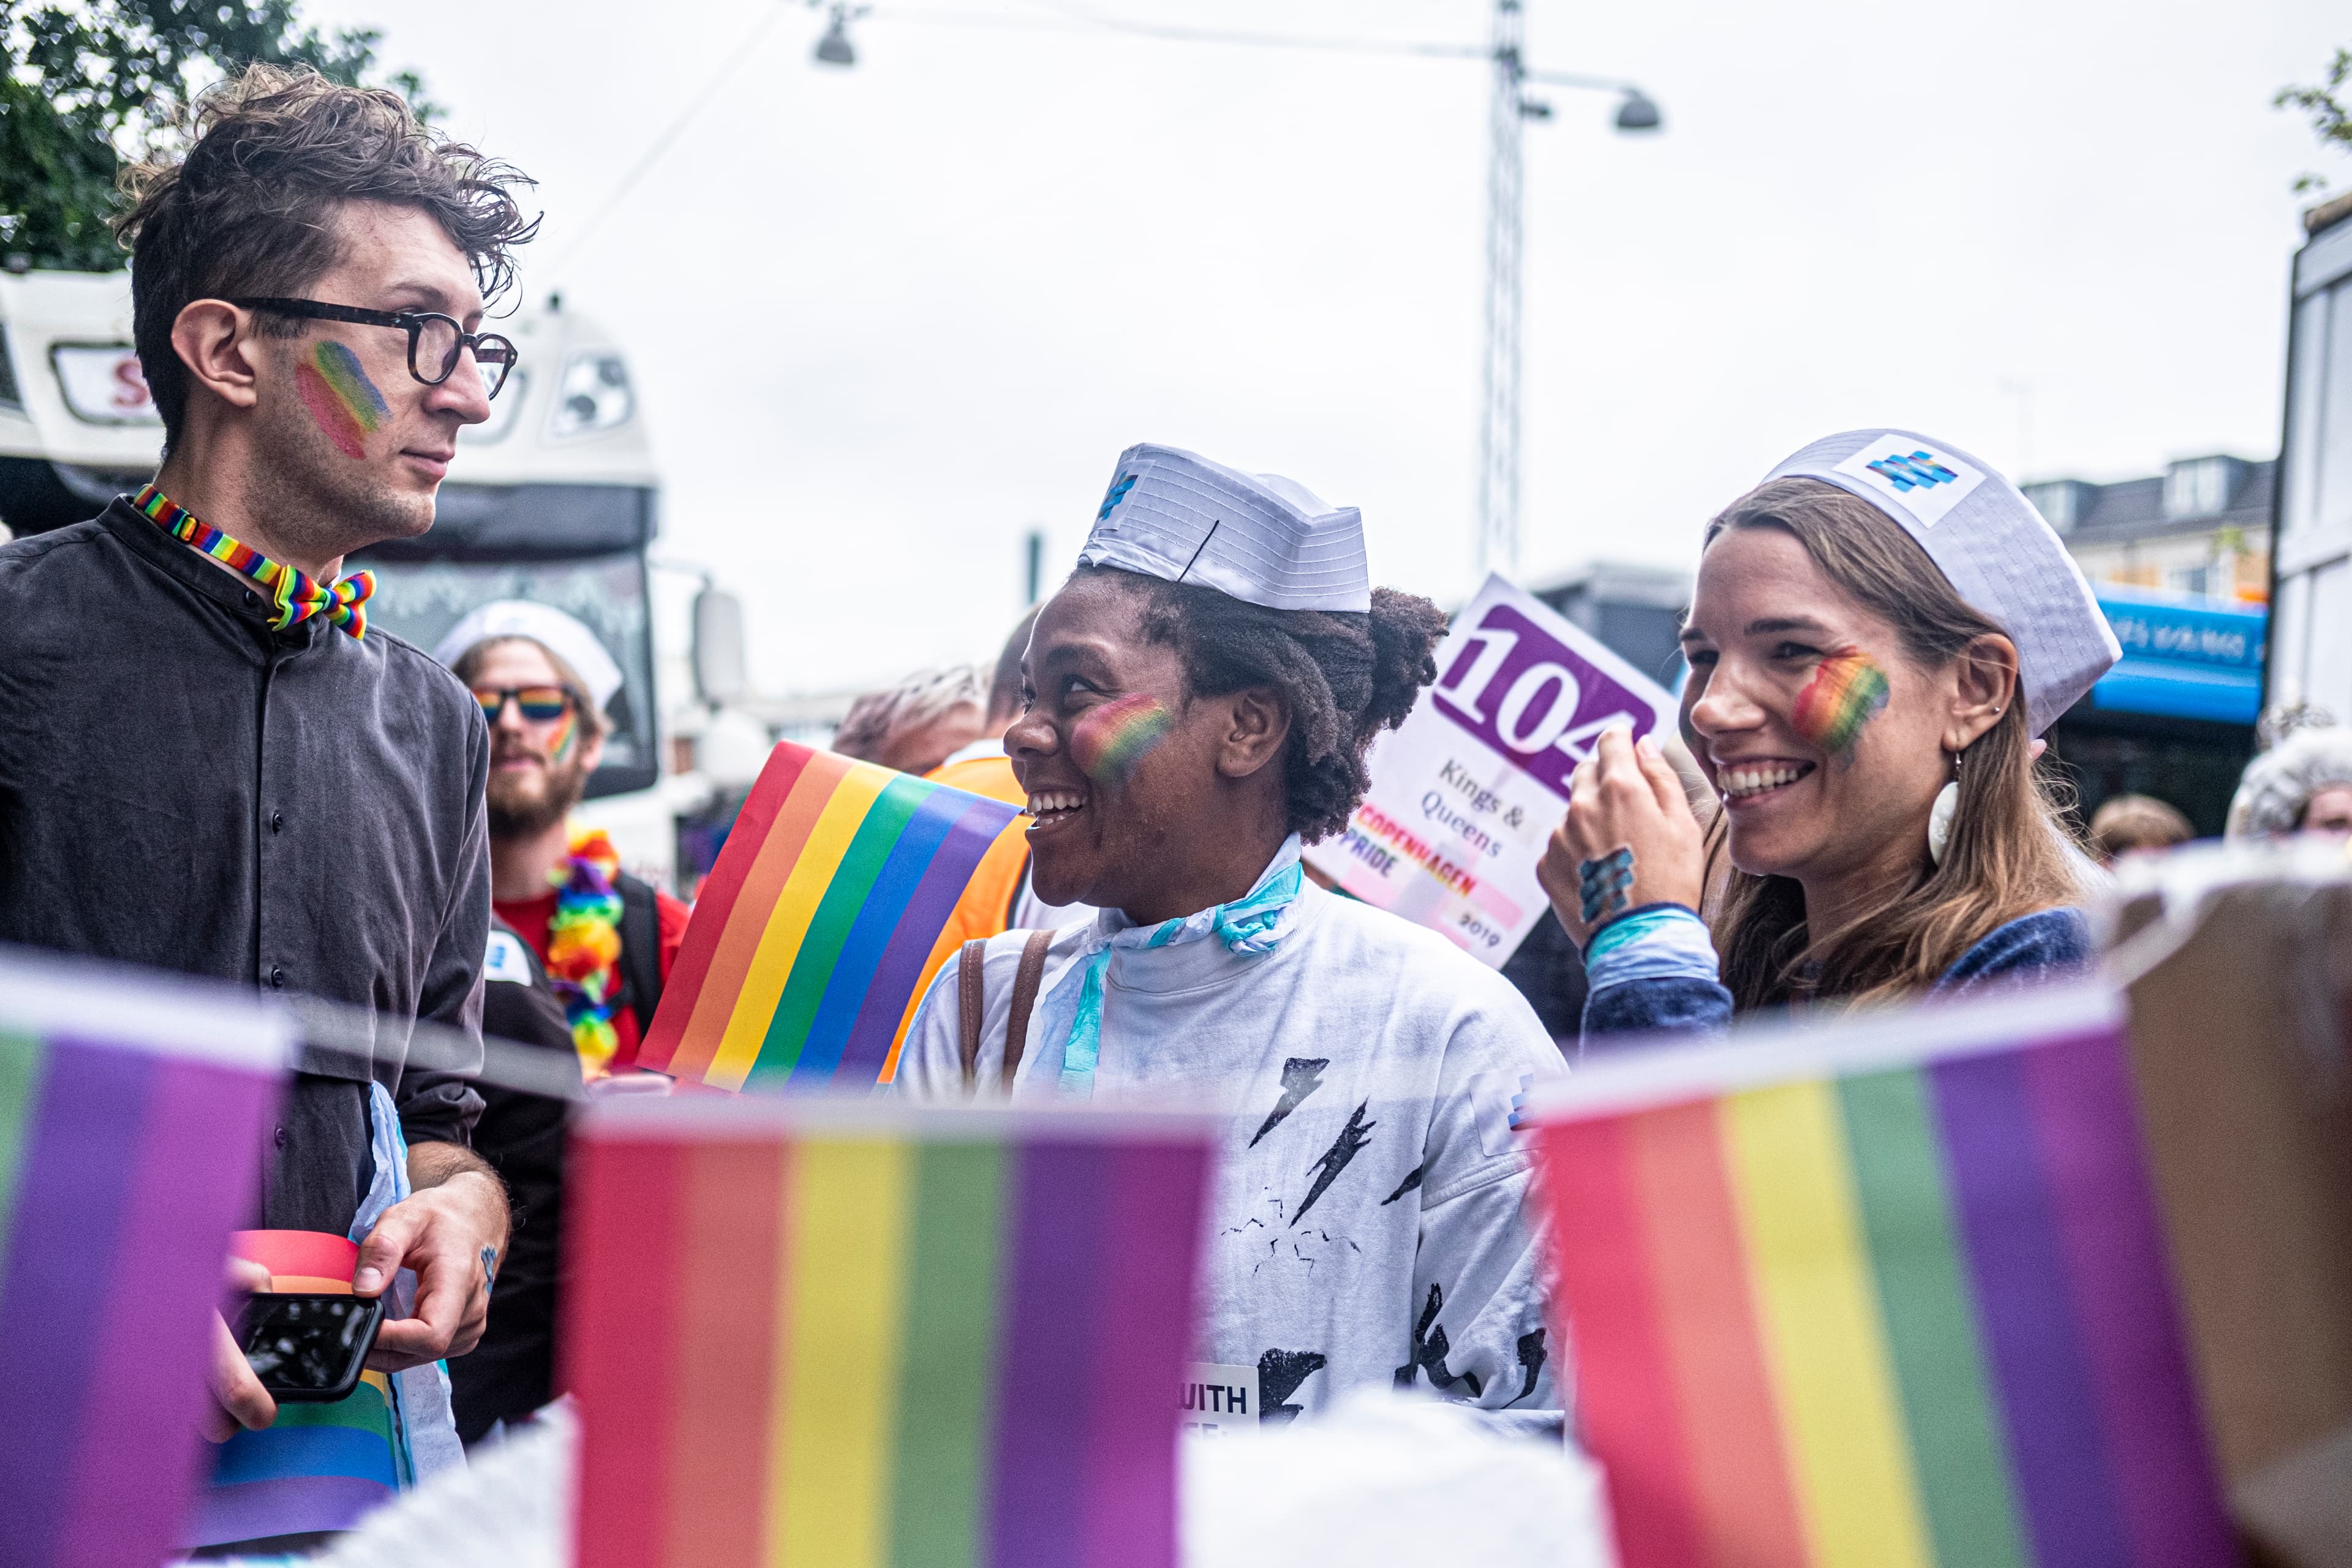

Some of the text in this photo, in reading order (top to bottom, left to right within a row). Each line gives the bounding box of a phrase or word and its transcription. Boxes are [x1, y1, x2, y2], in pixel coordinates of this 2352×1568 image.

[1421, 790, 1502, 858] Queens
[1439, 758, 1525, 829] Kings &
[1338, 826, 1399, 877] PRIDE
[1355, 802, 1477, 899] COPENHAGEN
[1458, 912, 1501, 948] 2019
